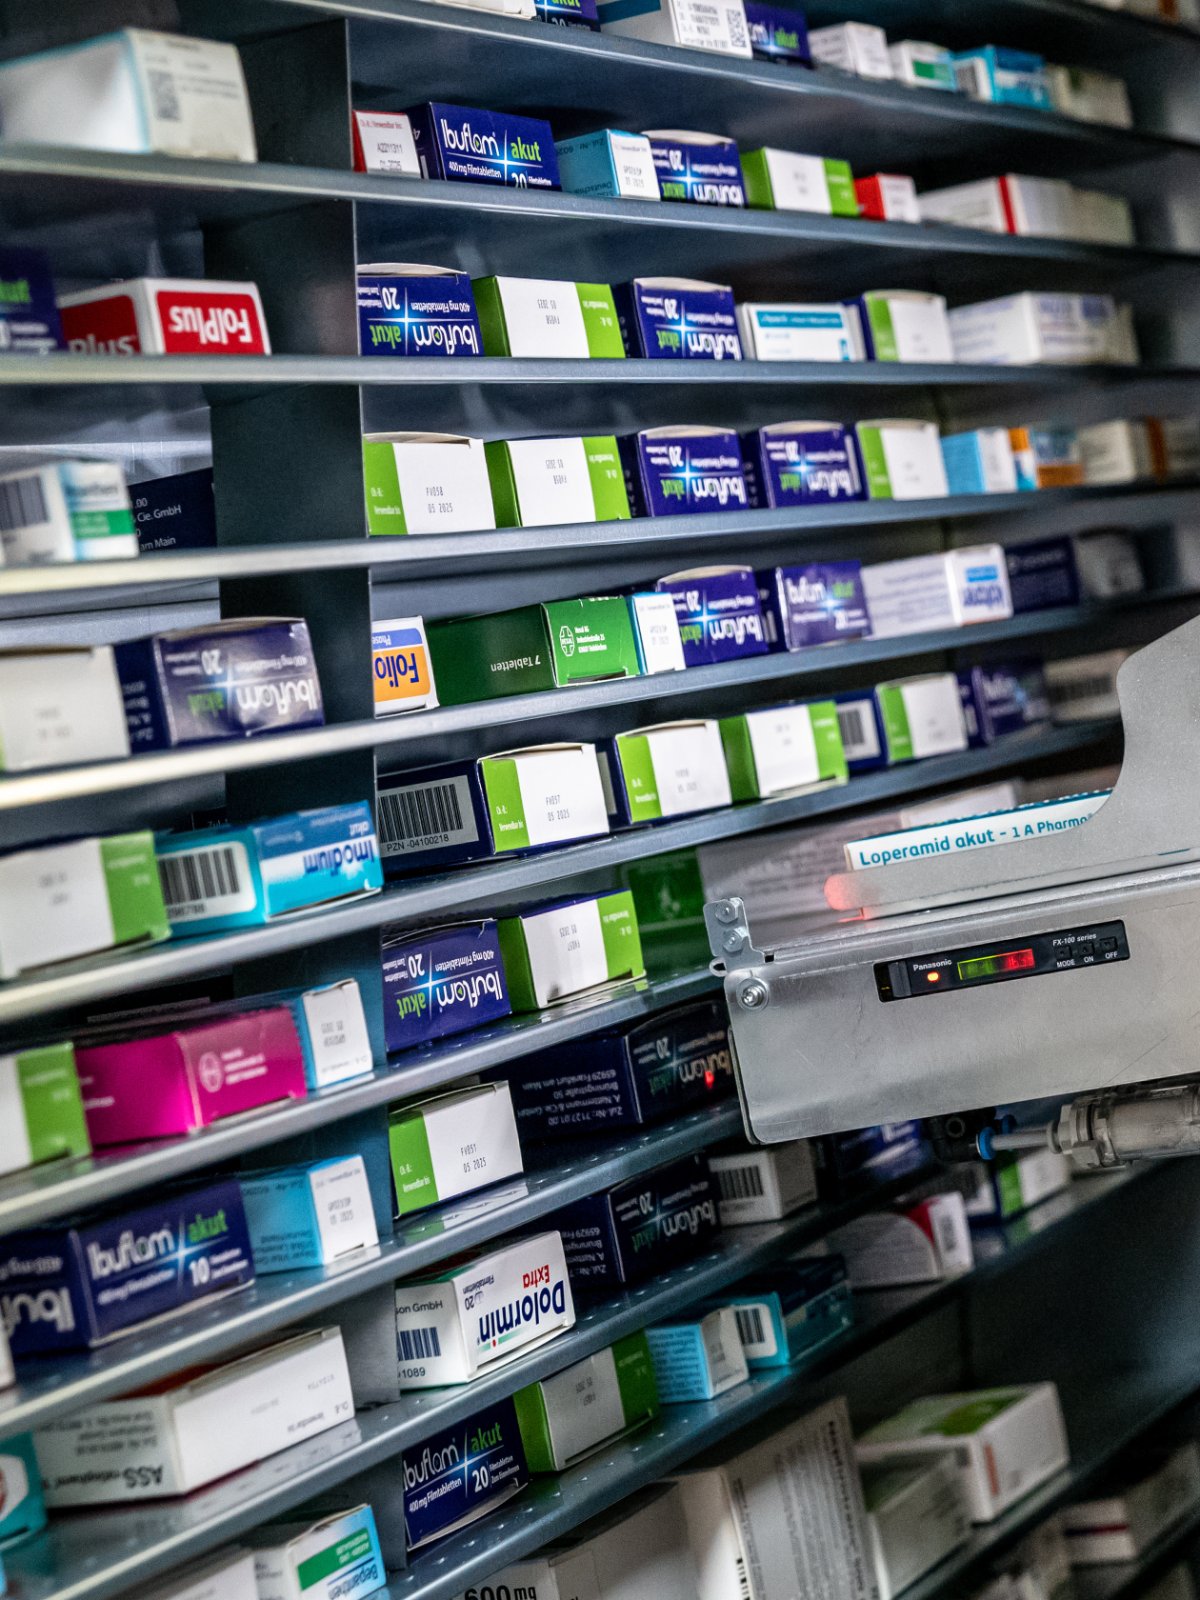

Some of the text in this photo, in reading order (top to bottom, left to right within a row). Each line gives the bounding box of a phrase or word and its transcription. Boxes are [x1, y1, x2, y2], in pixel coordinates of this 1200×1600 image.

[440, 118, 542, 162] Ibuflam akut
[382, 287, 400, 310] 20
[169, 305, 253, 344] FolPlus
[371, 324, 480, 354] Ibuflam akut
[153, 504, 182, 519] GmbH
[154, 536, 177, 548] Main
[374, 652, 419, 688] Folio
[490, 654, 542, 673] 7 Tabletten
[237, 679, 318, 717] Ibuflam
[386, 834, 450, 852] PZN -04100218
[859, 834, 951, 866] Loperamid
[955, 829, 996, 849] akut
[1012, 826, 1020, 839] 1
[1024, 823, 1035, 836] A
[303, 839, 375, 877] Imodium
[1052, 932, 1097, 947] FX-100 series
[408, 953, 425, 980] 20
[913, 958, 953, 971] Panasonic
[1056, 959, 1076, 968] MODE
[1083, 955, 1094, 963] ON
[1104, 951, 1118, 959] OFF
[396, 970, 503, 1019] Ibuflam akut
[473, 1157, 487, 1171] 2025
[189, 1260, 210, 1287] 10
[522, 1264, 550, 1290] Extra
[412, 1300, 443, 1312] GmbH
[464, 1298, 475, 1311] 20
[478, 1280, 566, 1348] Dolormin
[470, 1422, 503, 1453] akut
[426, 1478, 462, 1501] Filmtabletten
[472, 1467, 490, 1493] 20
[514, 1586, 537, 1600] mg
